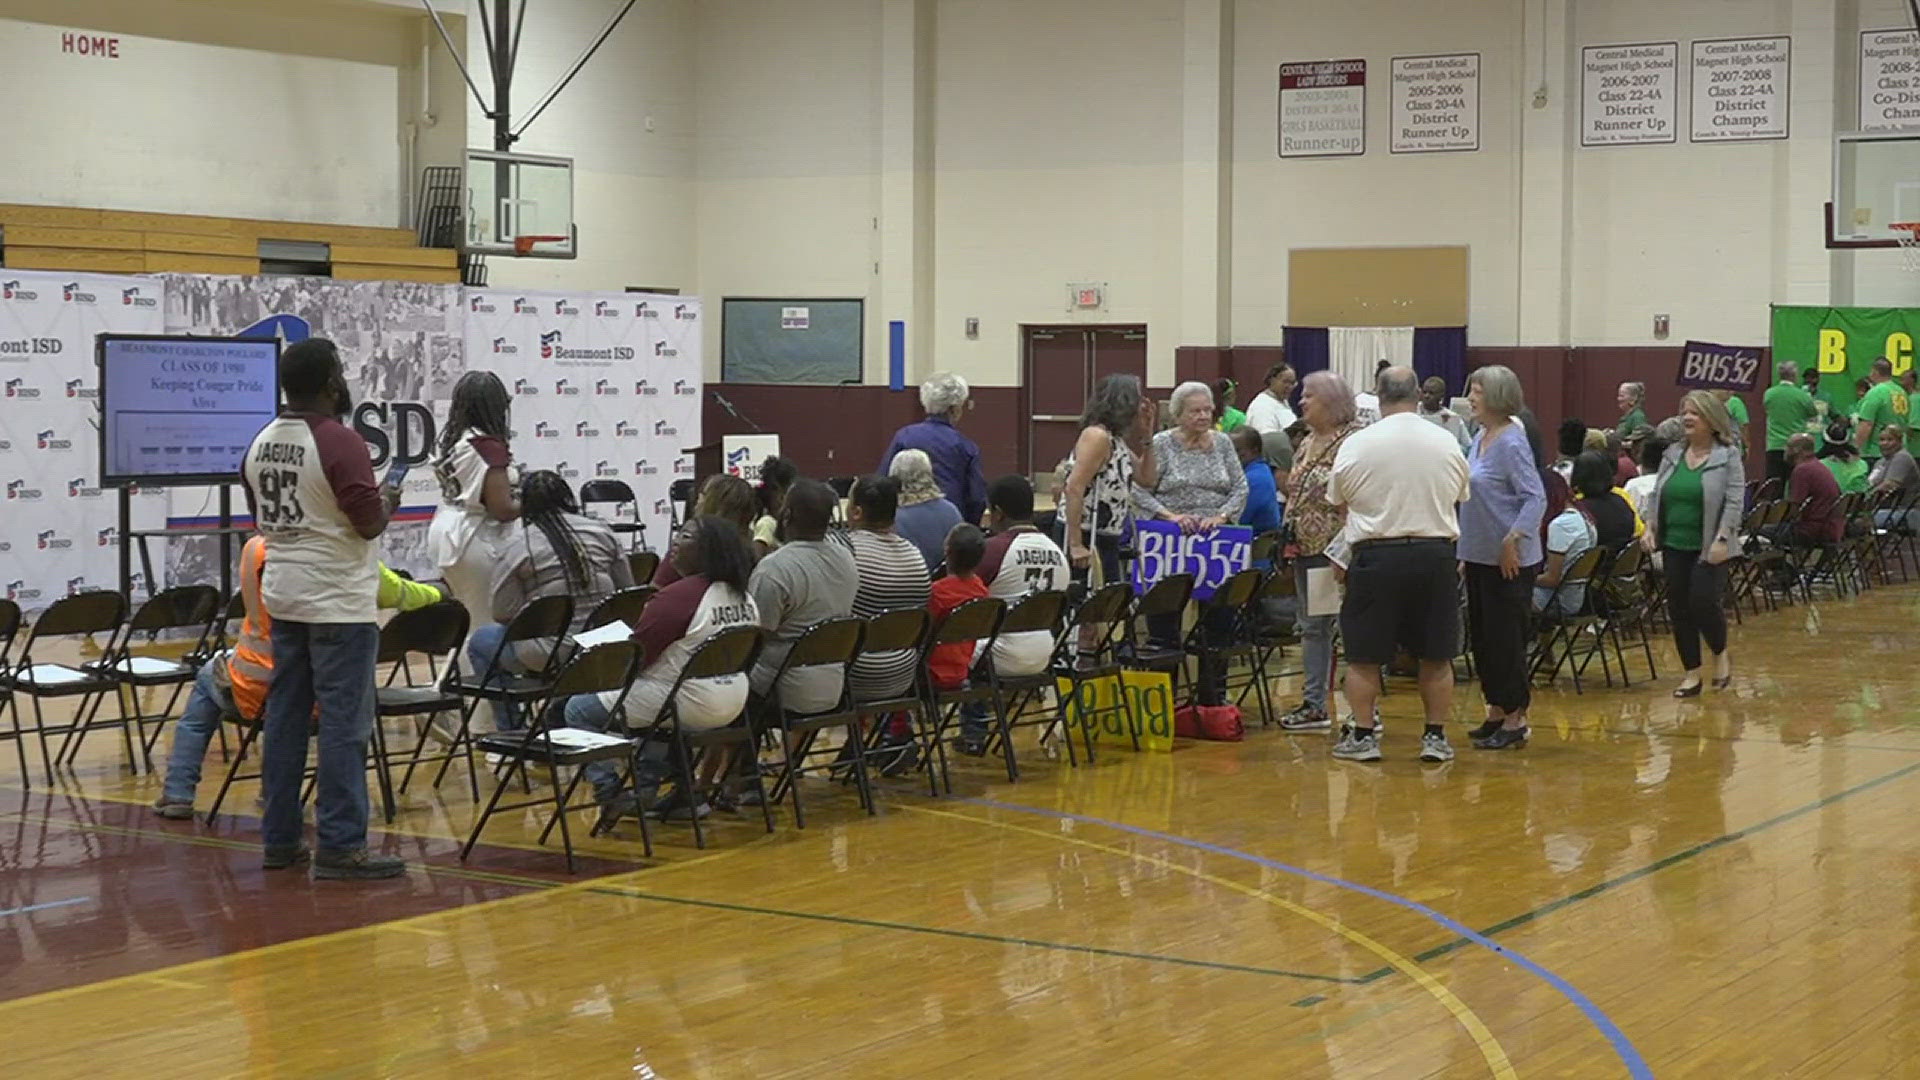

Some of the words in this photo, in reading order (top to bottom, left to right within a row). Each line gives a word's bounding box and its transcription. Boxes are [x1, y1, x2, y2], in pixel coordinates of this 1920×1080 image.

[62, 33, 119, 59] HOME
[1874, 33, 1910, 45] Central
[1595, 49, 1628, 60] Central
[1629, 47, 1665, 58] Medical
[1705, 44, 1739, 55] Central
[1740, 41, 1777, 52] Medical
[1864, 48, 1900, 59] Magnet
[1902, 46, 1920, 58] Hig
[1335, 61, 1364, 73] SCHOOL
[1403, 60, 1433, 70] Central
[1435, 58, 1468, 68] Medical
[1586, 63, 1618, 74] Magnet
[1620, 60, 1642, 72] High
[1644, 59, 1674, 70] School
[1696, 57, 1729, 69] Magnet
[1731, 55, 1753, 67] High
[1755, 53, 1786, 64] School
[1880, 61, 1920, 75] 2008-2
[1394, 73, 1425, 83] Magnet
[1426, 71, 1447, 82] High
[1448, 69, 1476, 80] School
[1601, 74, 1660, 88] 2006-2007
[1711, 69, 1772, 83] 2007-2008
[1877, 77, 1909, 89] Class
[1912, 76, 1920, 88] 2
[1408, 83, 1464, 98] 2005-2006
[1598, 90, 1627, 103] Class
[1629, 89, 1662, 101] 22-4A
[1708, 85, 1737, 98] Class
[1740, 84, 1774, 96] 22-4A
[1405, 100, 1433, 111] Class
[1434, 98, 1465, 110] 20-4A
[1873, 91, 1920, 105] Co-Dis
[1605, 103, 1655, 117] District
[1715, 99, 1767, 112] District
[1412, 111, 1459, 125] District
[1594, 120, 1643, 131] Runner
[1647, 117, 1667, 132] Up
[1712, 114, 1769, 128] Champs
[1402, 127, 1448, 139] Runner
[1451, 125, 1470, 139] Up
[1284, 136, 1360, 152] Runner-up
[31, 338, 63, 354] ISD
[555, 346, 612, 360] Beaumont
[614, 347, 635, 360] ISD
[1818, 327, 1847, 374] B
[1886, 332, 1913, 377] C
[161, 360, 201, 373] CLASS
[203, 361, 219, 374] OF
[1684, 350, 1757, 387] BHS'52
[151, 377, 195, 393] Keeping
[197, 378, 234, 394] Cougar
[237, 380, 264, 392] Pride
[192, 397, 216, 408] Alive
[255, 442, 306, 467] JAGUAR
[258, 468, 305, 525] 93
[1016, 549, 1063, 567] JAGUAR
[1138, 529, 1252, 589] BHS'54
